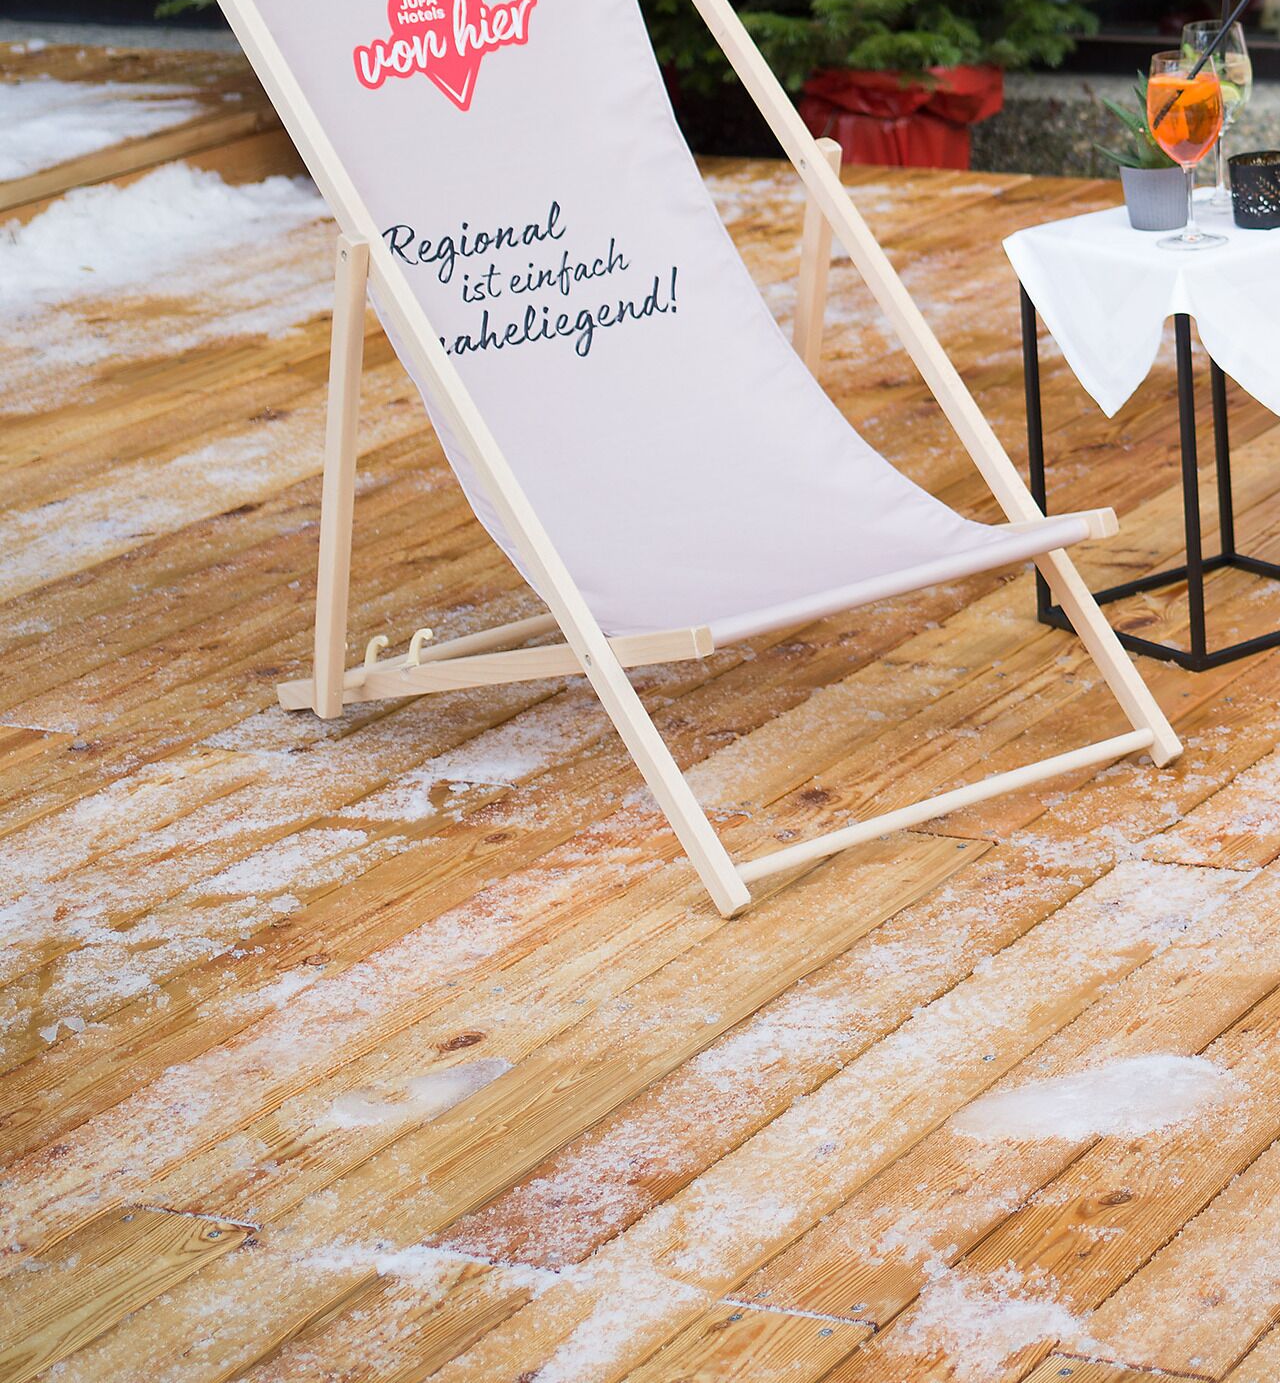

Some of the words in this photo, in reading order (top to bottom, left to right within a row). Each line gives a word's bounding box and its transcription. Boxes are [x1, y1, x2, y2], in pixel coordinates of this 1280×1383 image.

[397, 7, 446, 24] Hotels
[360, 30, 447, 84] von
[382, 200, 566, 284] Regional
[462, 264, 501, 303] ist
[509, 238, 632, 296] einfach
